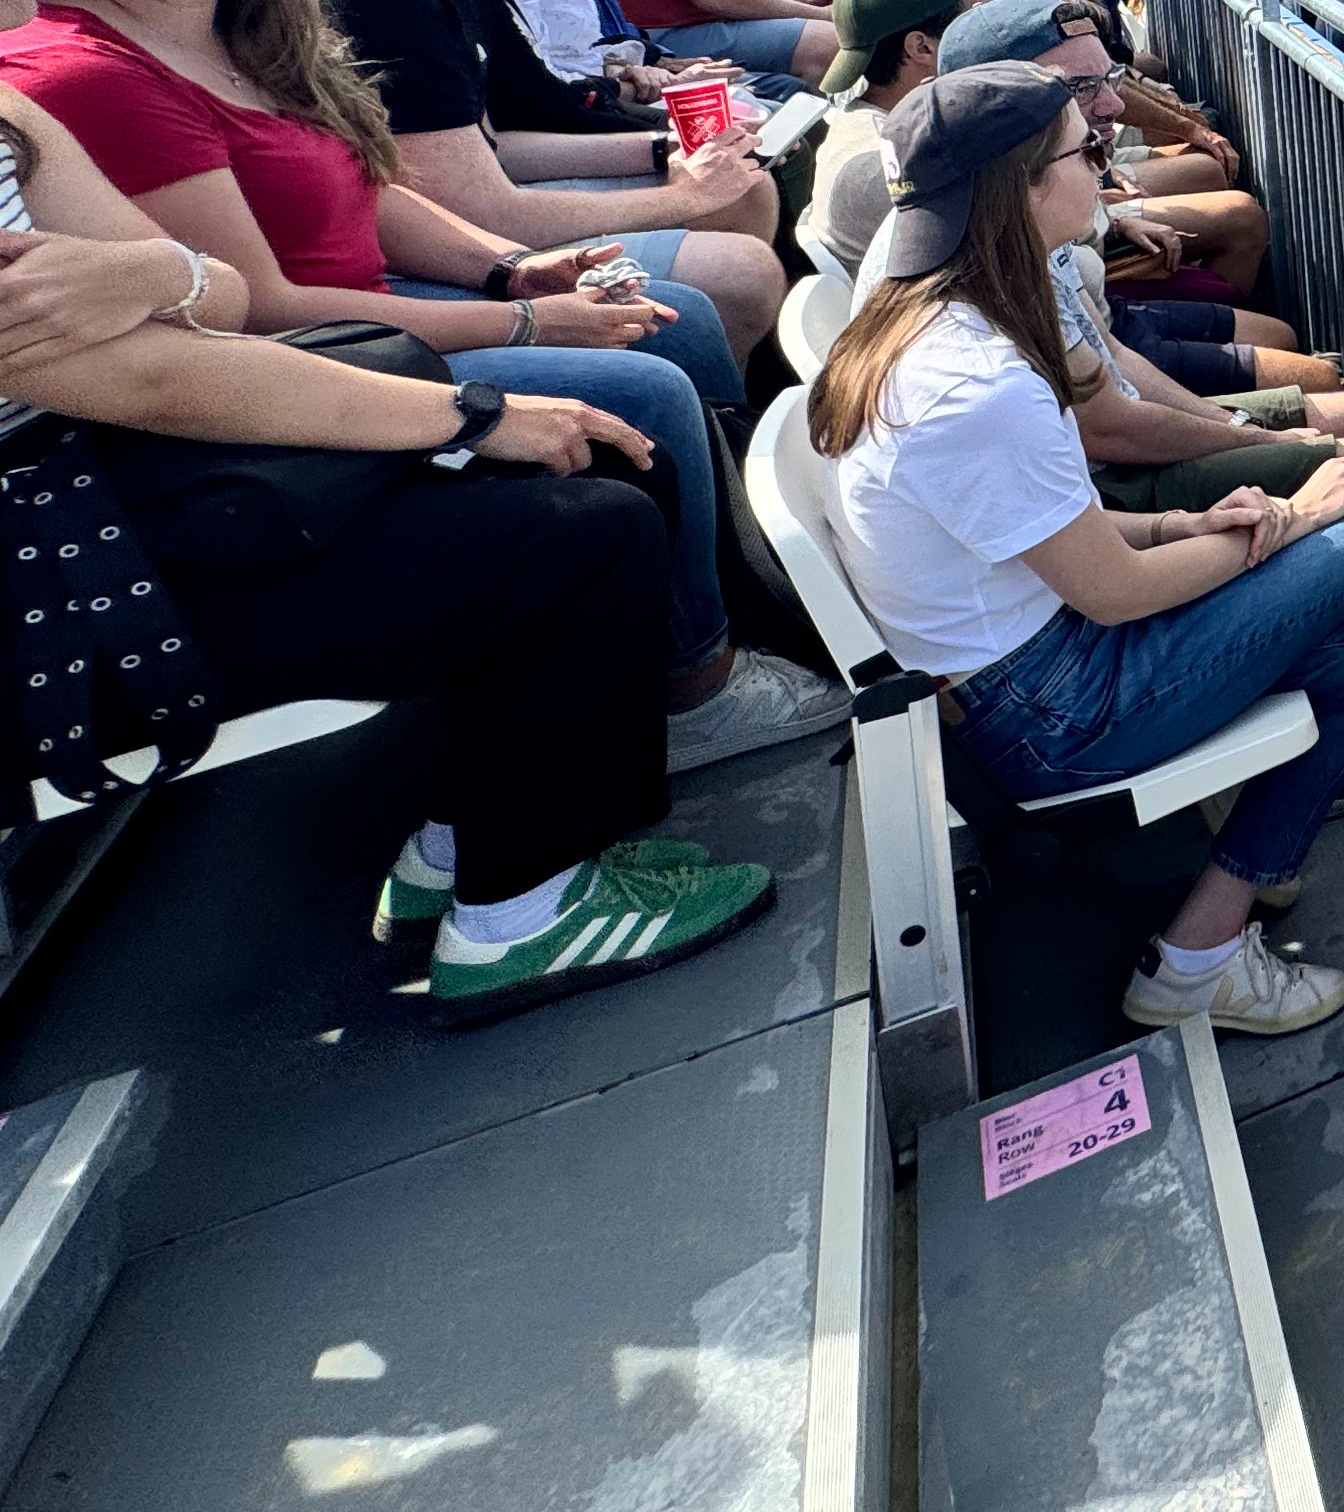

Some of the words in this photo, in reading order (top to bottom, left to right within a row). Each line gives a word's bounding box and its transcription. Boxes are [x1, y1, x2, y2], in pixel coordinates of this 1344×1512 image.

[1098, 1066, 1127, 1087] C1
[1103, 1088, 1131, 1115] 4
[996, 1124, 1045, 1152] Rang
[1067, 1118, 1136, 1158] 20-29
[998, 1142, 1036, 1164] Row
